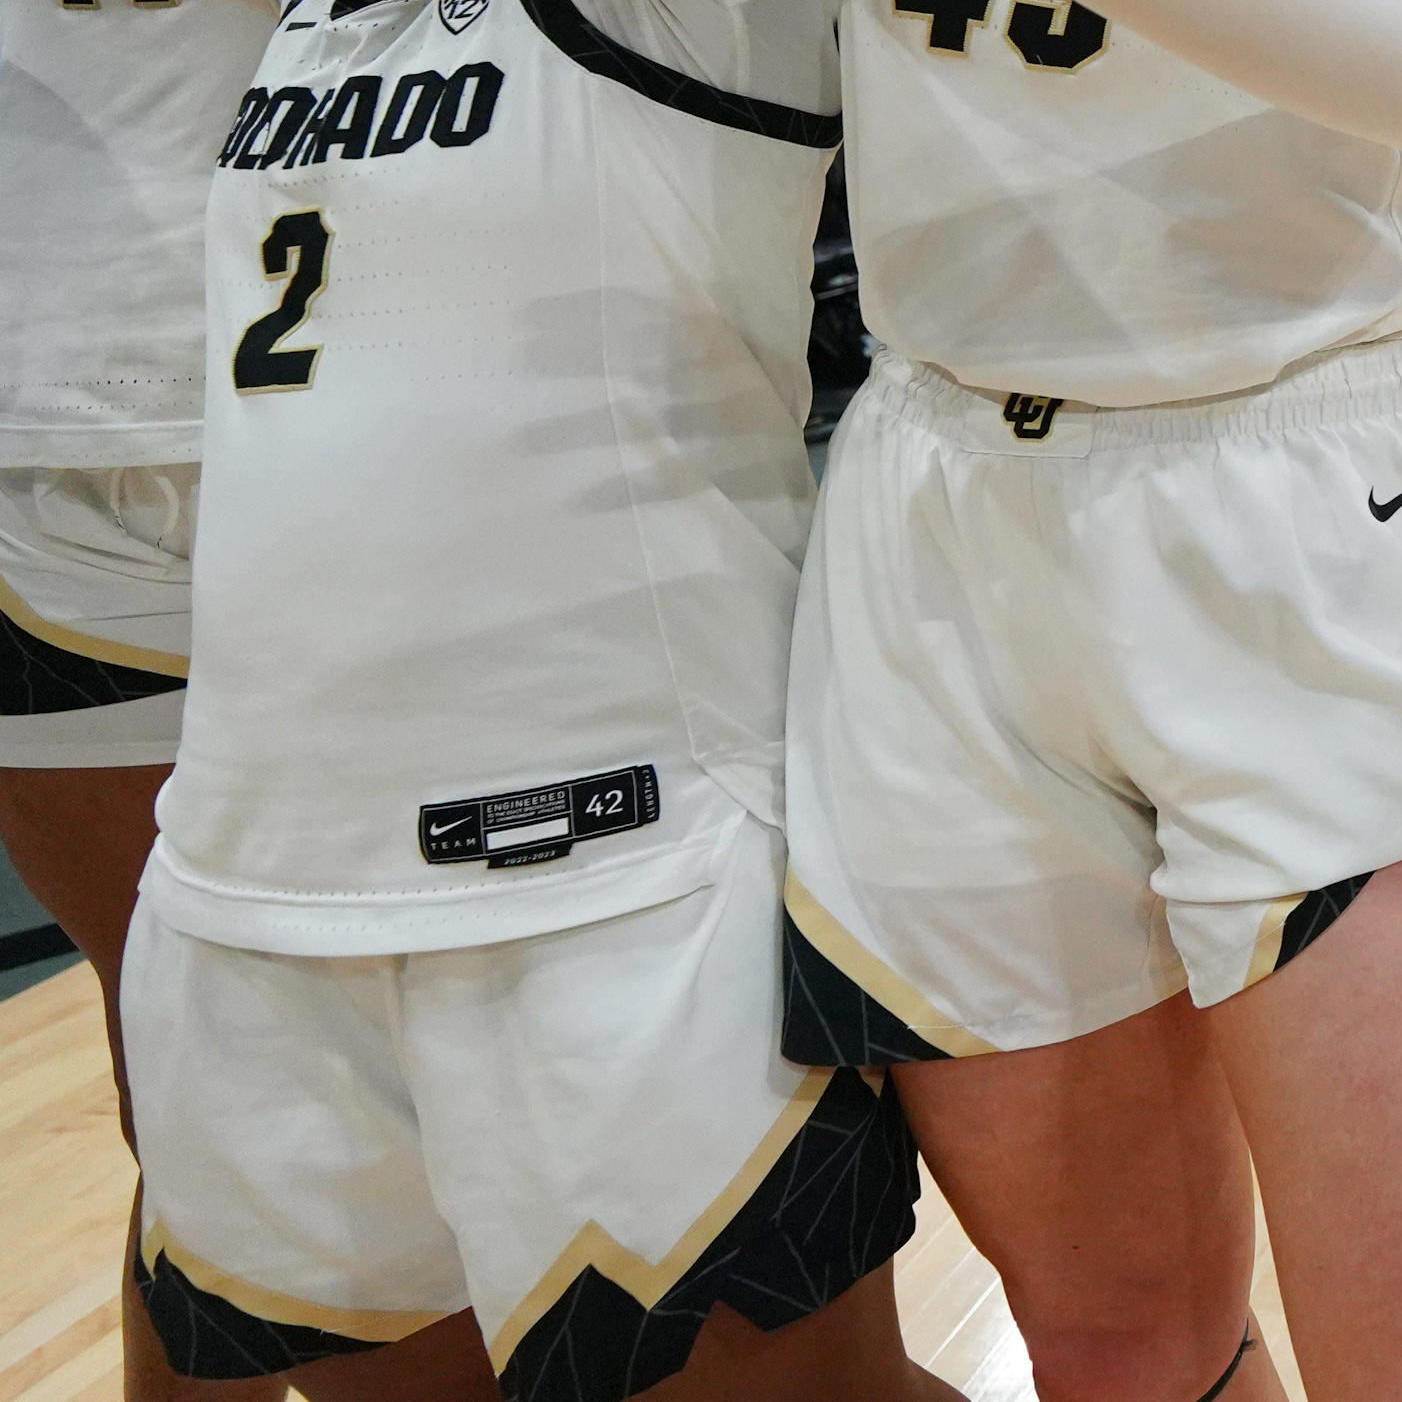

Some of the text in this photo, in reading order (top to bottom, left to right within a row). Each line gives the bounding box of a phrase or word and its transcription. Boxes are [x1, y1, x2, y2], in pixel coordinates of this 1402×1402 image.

[216, 61, 505, 170] OLORADO
[232, 205, 336, 395] 2
[486, 790, 566, 814] ENGINEERED
[586, 789, 624, 818] 42
[431, 837, 477, 851] TEAM
